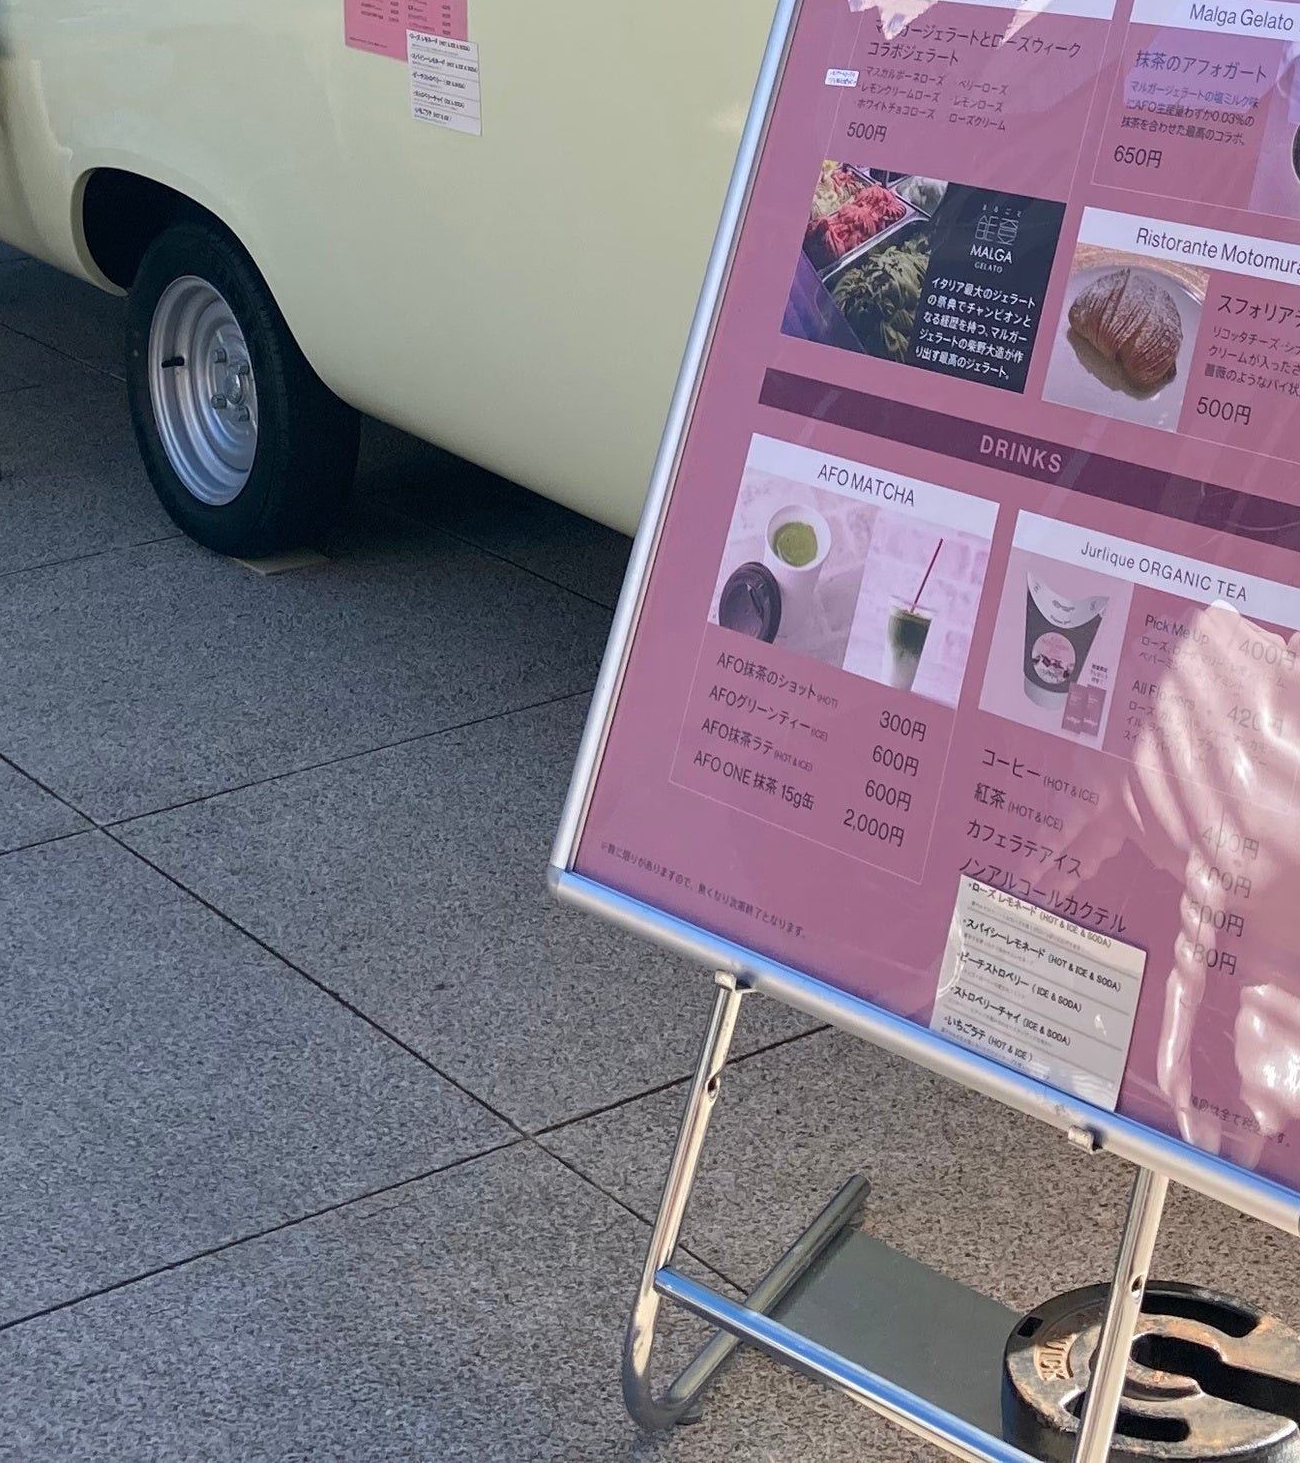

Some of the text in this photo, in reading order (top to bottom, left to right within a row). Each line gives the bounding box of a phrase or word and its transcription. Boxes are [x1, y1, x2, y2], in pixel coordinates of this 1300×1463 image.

[1189, 2, 1238, 26] Malga
[1240, 8, 1294, 31] Gelato
[867, 41, 960, 67] コラボジェラート
[1134, 49, 1268, 84] 抹茶のアフォガート
[846, 121, 888, 143] 500円
[1113, 144, 1163, 169] 650円
[969, 243, 1014, 265] MALGA
[1135, 226, 1219, 259] Ristorante
[974, 261, 1004, 274] GELATO
[931, 276, 1037, 309] イタリア最大のジェラート
[1196, 396, 1252, 426] 500円
[979, 434, 1063, 474] DRINKS
[817, 463, 915, 508] AFO MATCHA
[1080, 540, 1248, 602] Jurlique ORGANIC TEA
[1144, 614, 1171, 634] Pick
[1172, 622, 1191, 639] Me
[716, 651, 817, 700] AFO抹茶のショット
[1131, 679, 1148, 696] All
[708, 684, 811, 730] AFOグリーンティー
[701, 716, 775, 756] AFO抹茶ラテ
[878, 709, 928, 742] 300円
[872, 744, 920, 777] 600円
[982, 748, 1041, 779] コーヒー
[693, 749, 816, 811] AFO ONE 抹茶 15g缶
[865, 778, 913, 813] 600円
[973, 781, 1007, 810] 紅茶
[843, 807, 906, 848] 2,000円
[966, 818, 1082, 878] カフェラテアイス
[958, 856, 1127, 934] ノンアルコールカクテル
[1195, 864, 1253, 899] 00円
[965, 918, 1046, 959] スパイシーレモネード
[1047, 952, 1068, 970] (HOT
[1075, 965, 1088, 979] ICE
[1096, 973, 1122, 993] SODA)
[1180, 938, 1238, 976] 80円
[953, 985, 1021, 1024] ストロベリーチャイ
